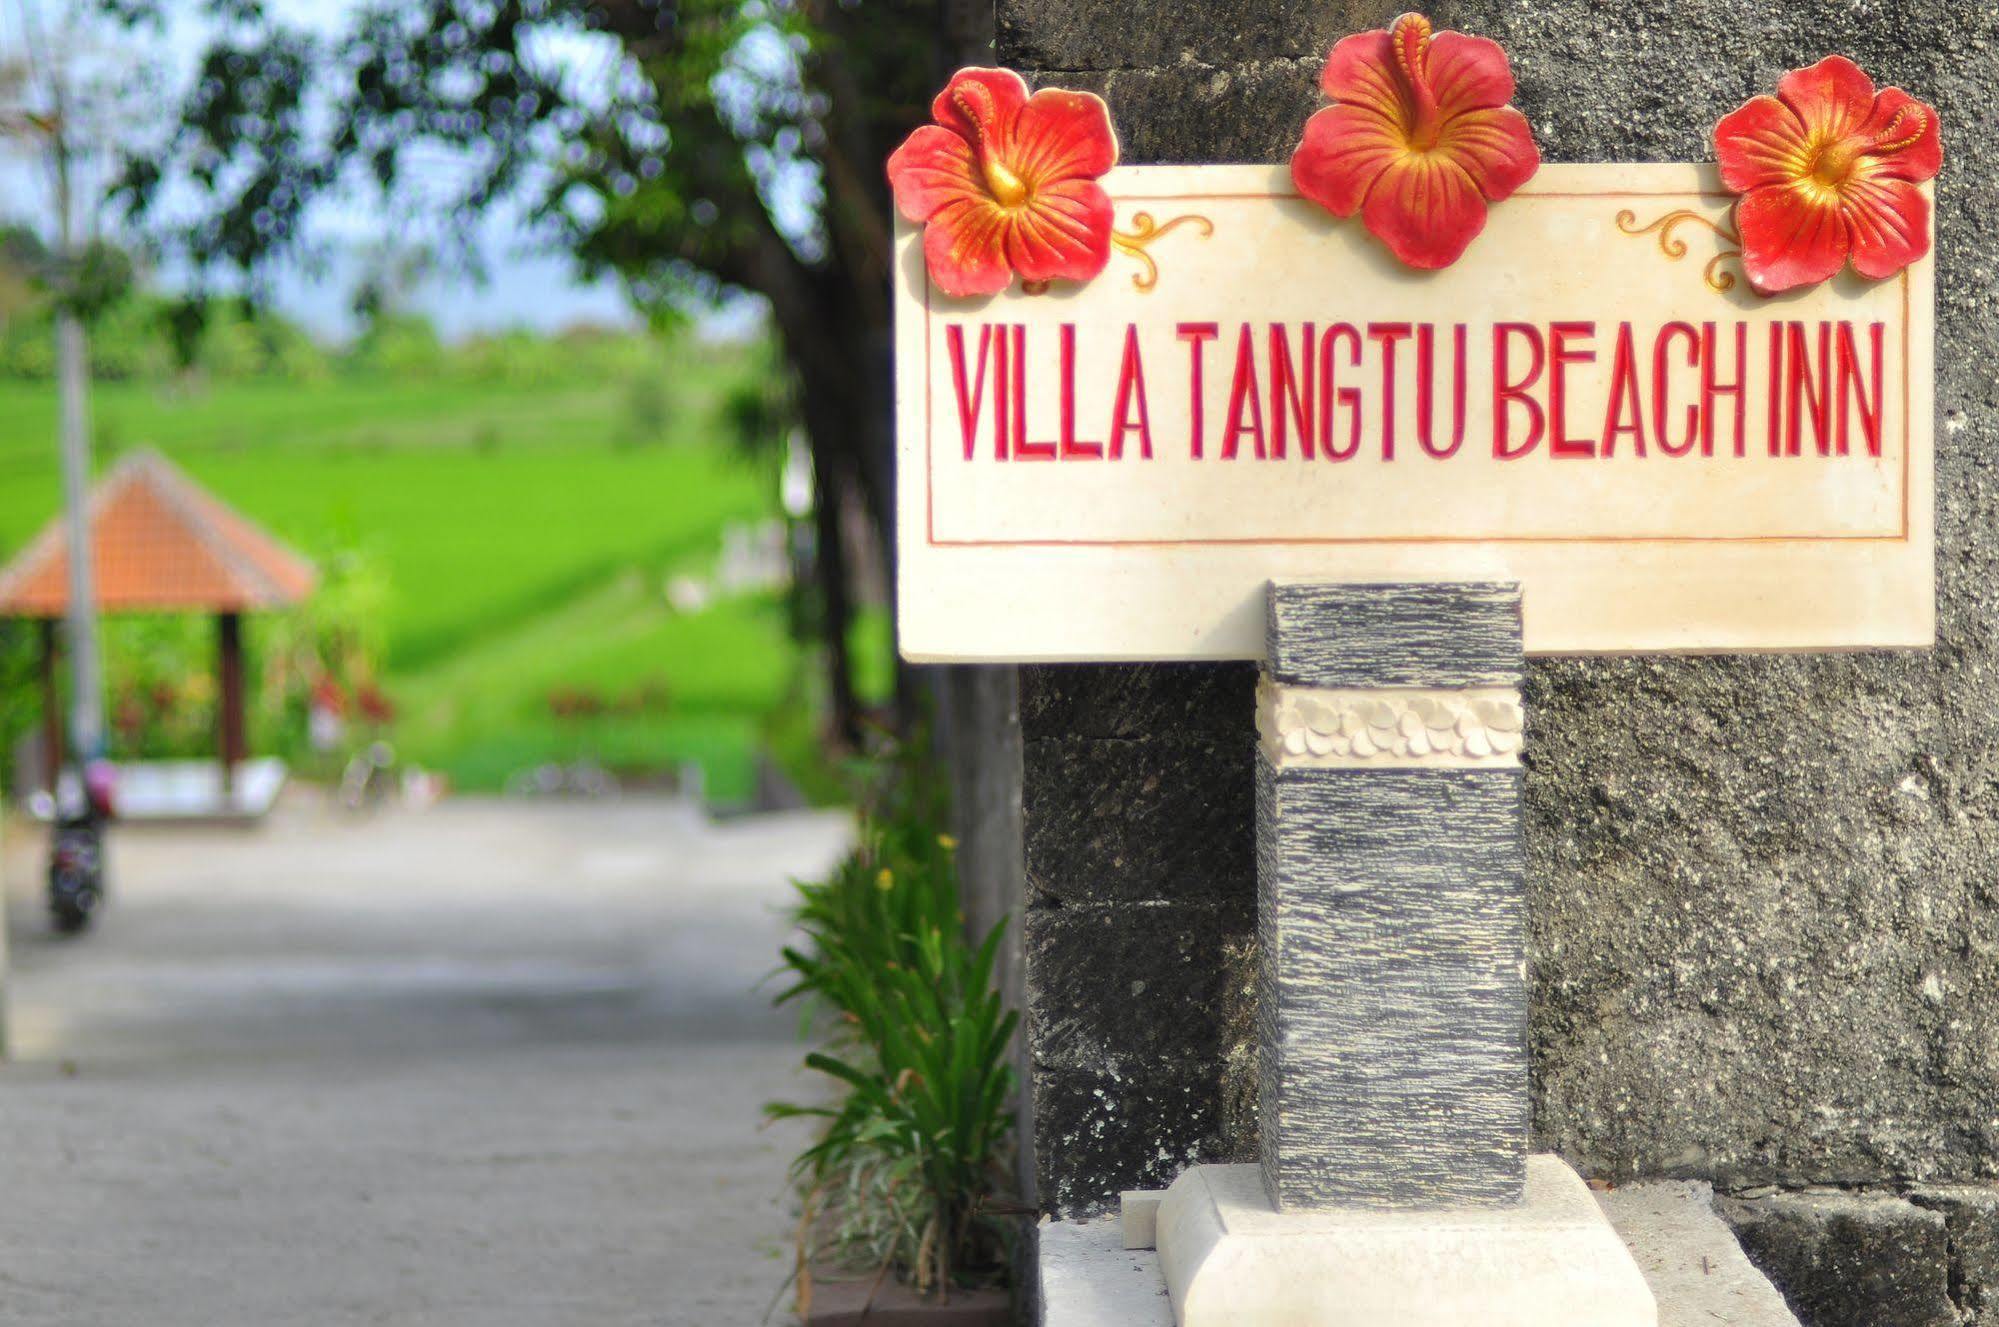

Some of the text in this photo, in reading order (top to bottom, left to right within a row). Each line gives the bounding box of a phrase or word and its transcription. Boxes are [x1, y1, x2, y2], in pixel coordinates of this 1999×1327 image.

[945, 320, 1885, 463] VILLA TANGTU BEACH INN
